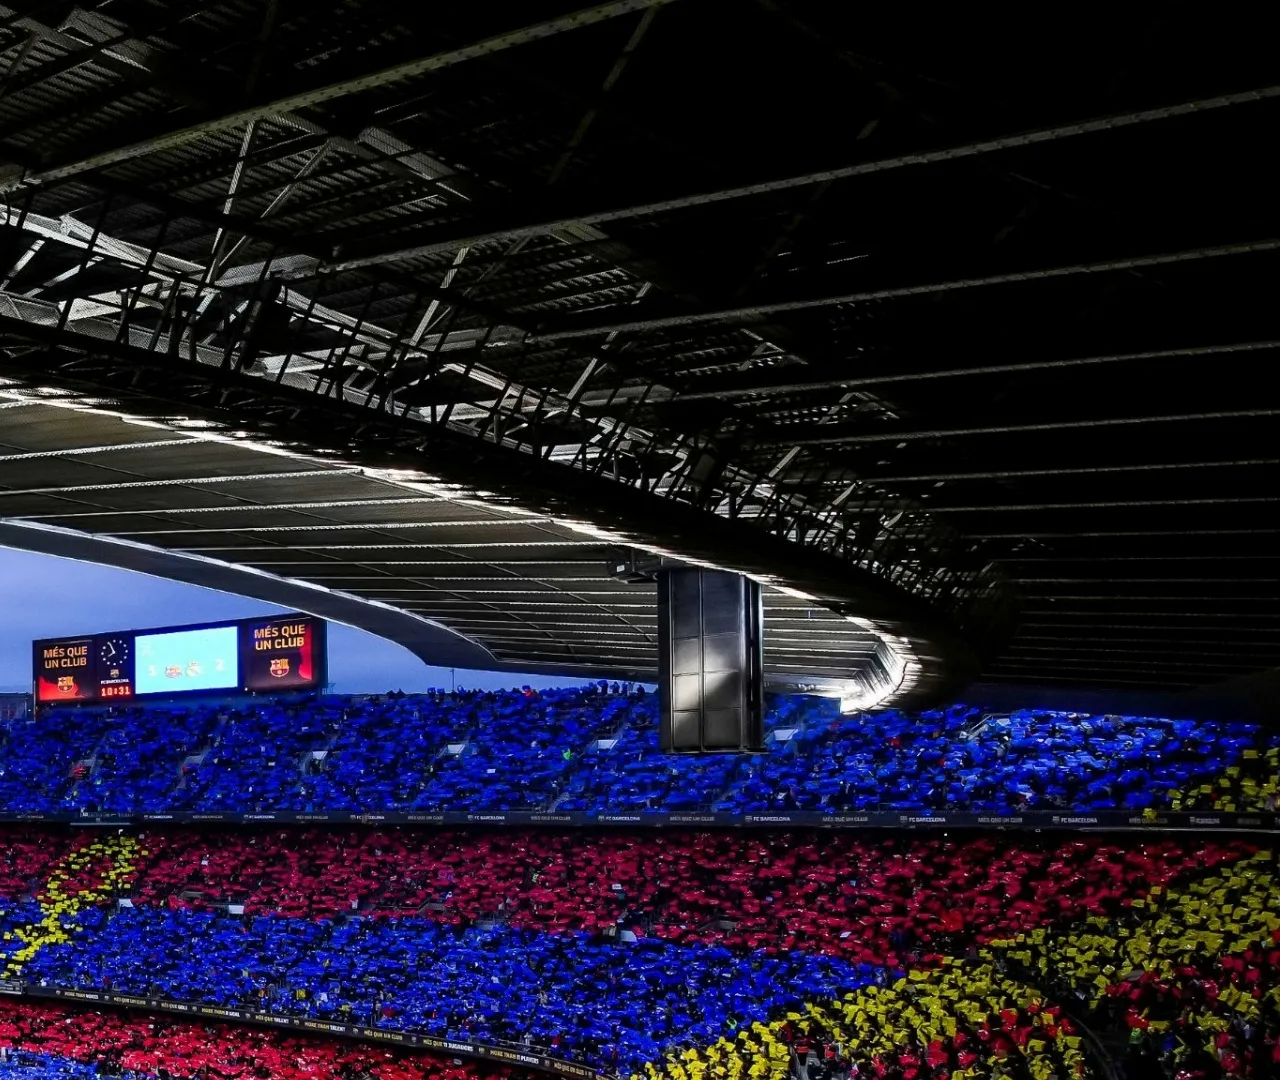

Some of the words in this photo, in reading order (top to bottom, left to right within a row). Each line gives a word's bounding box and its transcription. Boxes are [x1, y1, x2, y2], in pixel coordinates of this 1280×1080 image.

[254, 625, 279, 639] MÉS
[282, 624, 306, 637] QUE
[255, 639, 271, 651] UN
[274, 637, 305, 649] CLUB
[44, 646, 65, 659] MÉS
[67, 645, 88, 657] QUE
[45, 658, 59, 669] UN
[61, 656, 87, 668] CLUB
[101, 686, 130, 697] 10:31
[490, 1049, 503, 1057] MORE
[504, 1052, 516, 1060] THAN
[521, 1055, 539, 1065] PLAYERS
